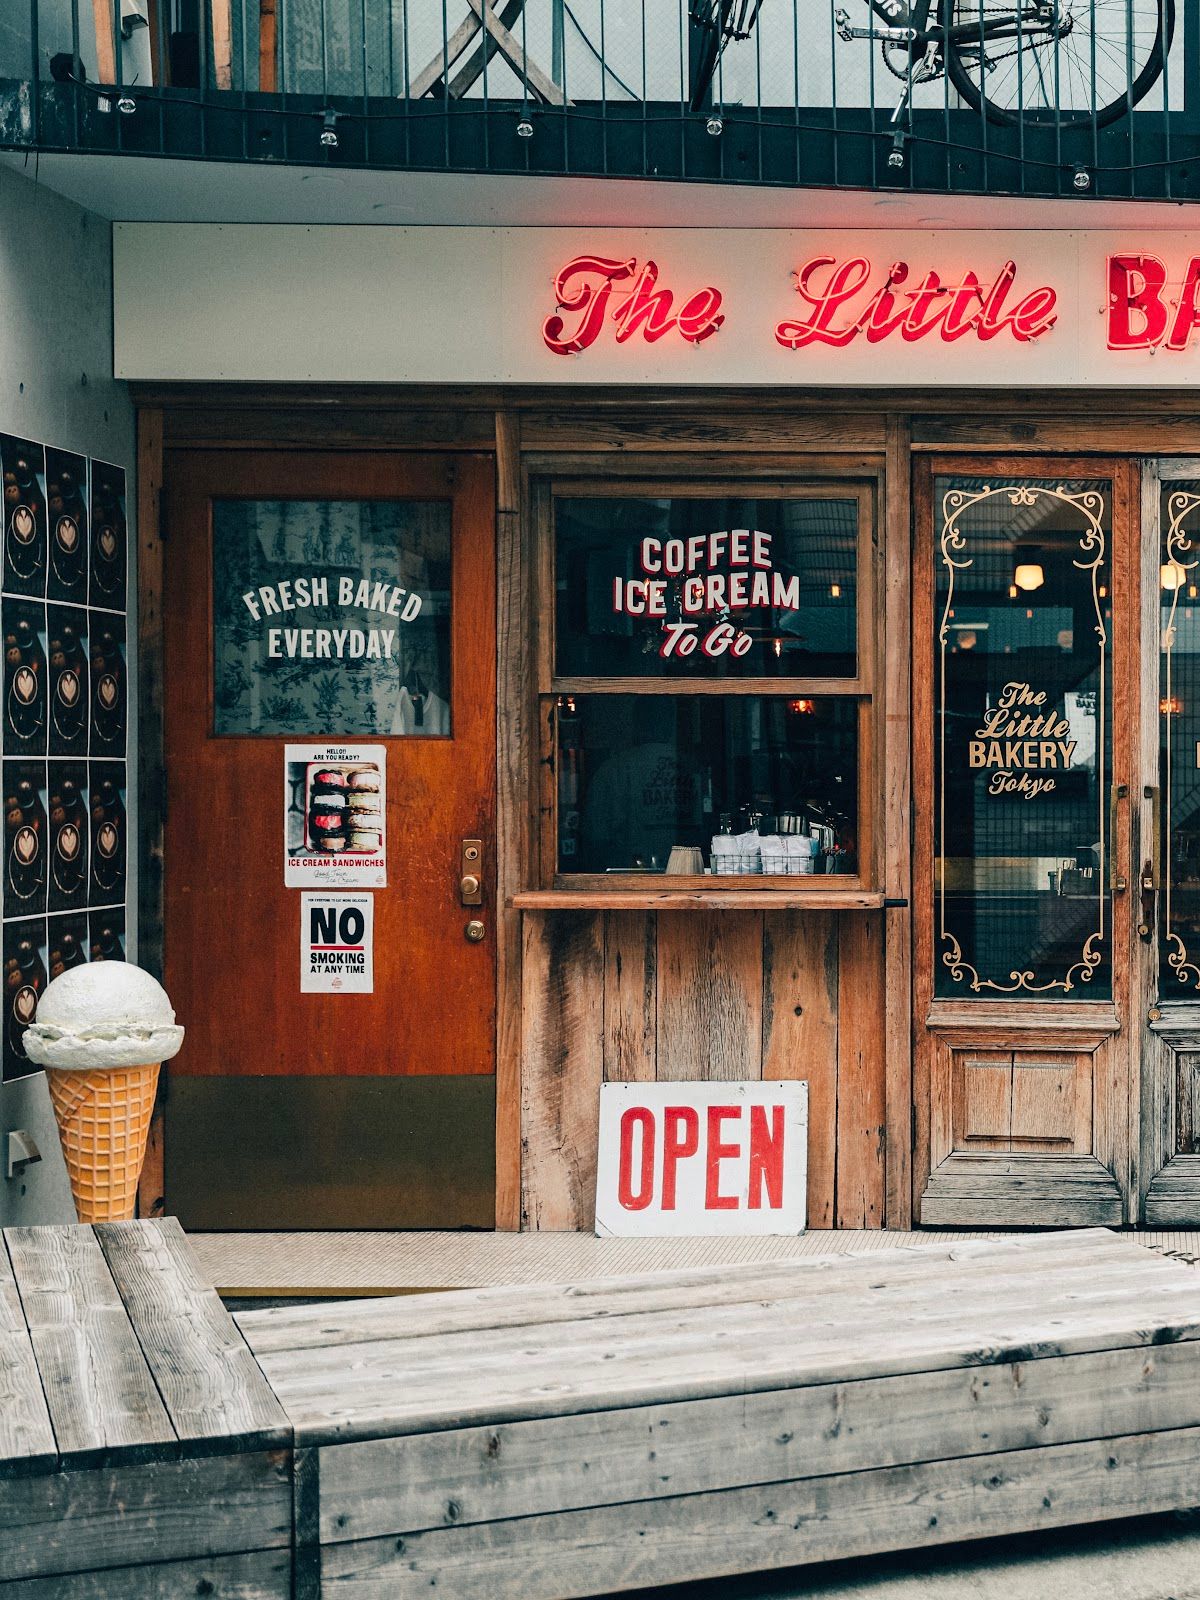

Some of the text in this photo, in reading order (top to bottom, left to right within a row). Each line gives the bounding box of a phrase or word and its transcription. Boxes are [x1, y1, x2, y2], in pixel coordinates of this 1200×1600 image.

[543, 255, 724, 356] The
[775, 255, 1059, 349] Little
[640, 529, 773, 575] COFFEE
[242, 576, 423, 622] FRESH BAKED
[613, 571, 800, 617] ICE CREAM
[268, 628, 396, 659] EVERYDAY
[660, 622, 753, 658] To Go
[998, 682, 1048, 709] The
[975, 708, 1070, 739] Little
[969, 741, 1077, 768] BAKERY
[988, 770, 1057, 800] Tokyo
[288, 859, 385, 867] ICE CREAM SANDWICHES
[310, 907, 365, 945] NO
[310, 952, 365, 964] SMOKING
[310, 965, 365, 973] AT ANY TIME
[617, 1104, 786, 1211] OPEN
